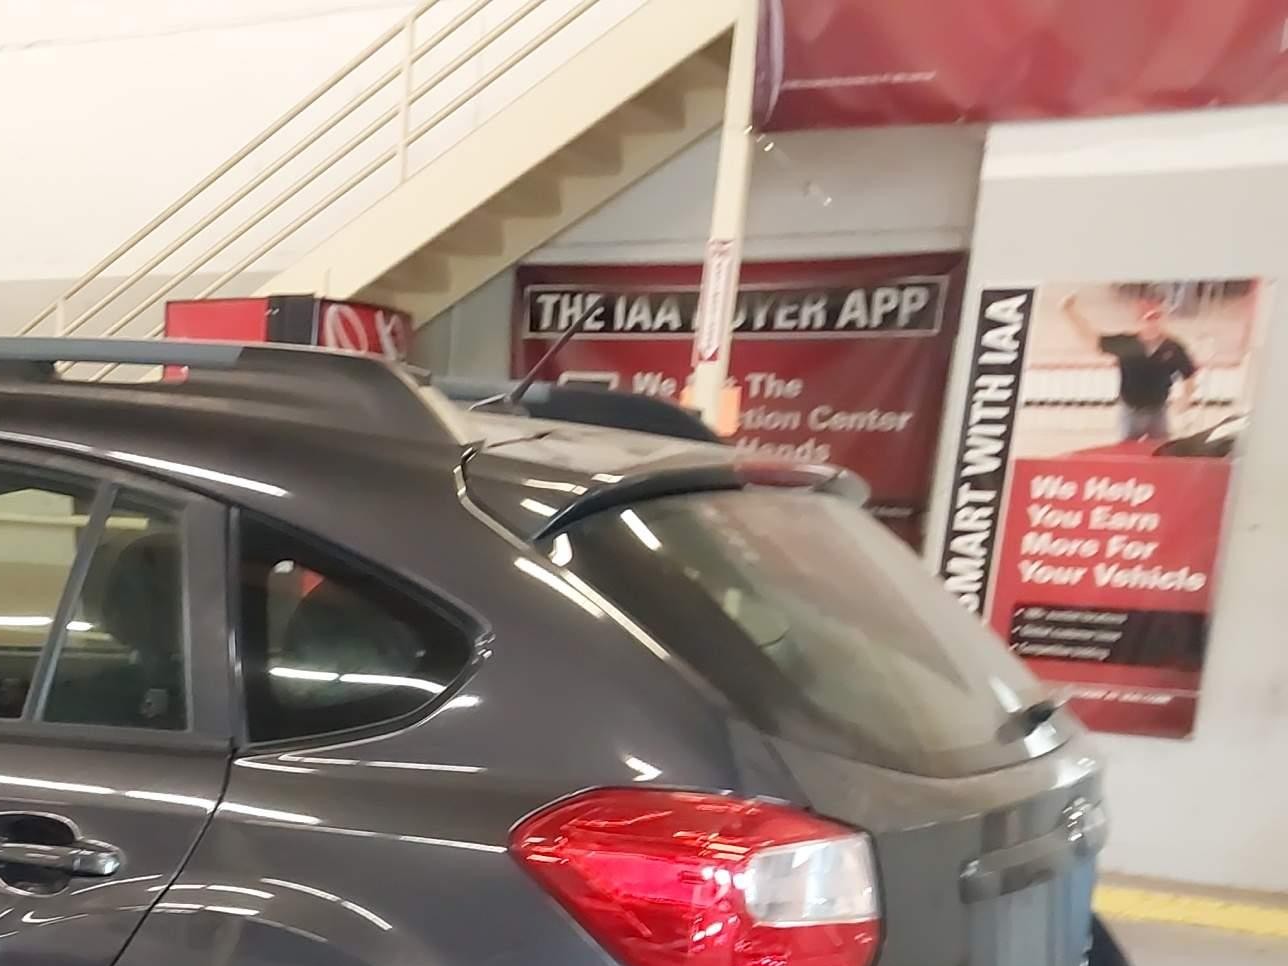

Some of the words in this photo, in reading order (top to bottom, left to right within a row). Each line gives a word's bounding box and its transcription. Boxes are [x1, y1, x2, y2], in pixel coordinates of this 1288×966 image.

[536, 293, 605, 331] THE
[614, 296, 682, 331] IAA
[835, 286, 929, 329] APP
[978, 293, 1028, 365] IAA
[631, 371, 678, 397] We
[744, 371, 804, 399] The
[807, 404, 913, 432] Center
[960, 374, 1016, 477] WITH
[1030, 475, 1078, 500] We
[1082, 476, 1154, 507] Help
[1027, 503, 1083, 528] You
[1088, 505, 1161, 531] Earn
[1020, 531, 1100, 558] More
[1105, 534, 1159, 560] For
[1018, 560, 1088, 586] Your
[1093, 562, 1207, 592] Vehicle
